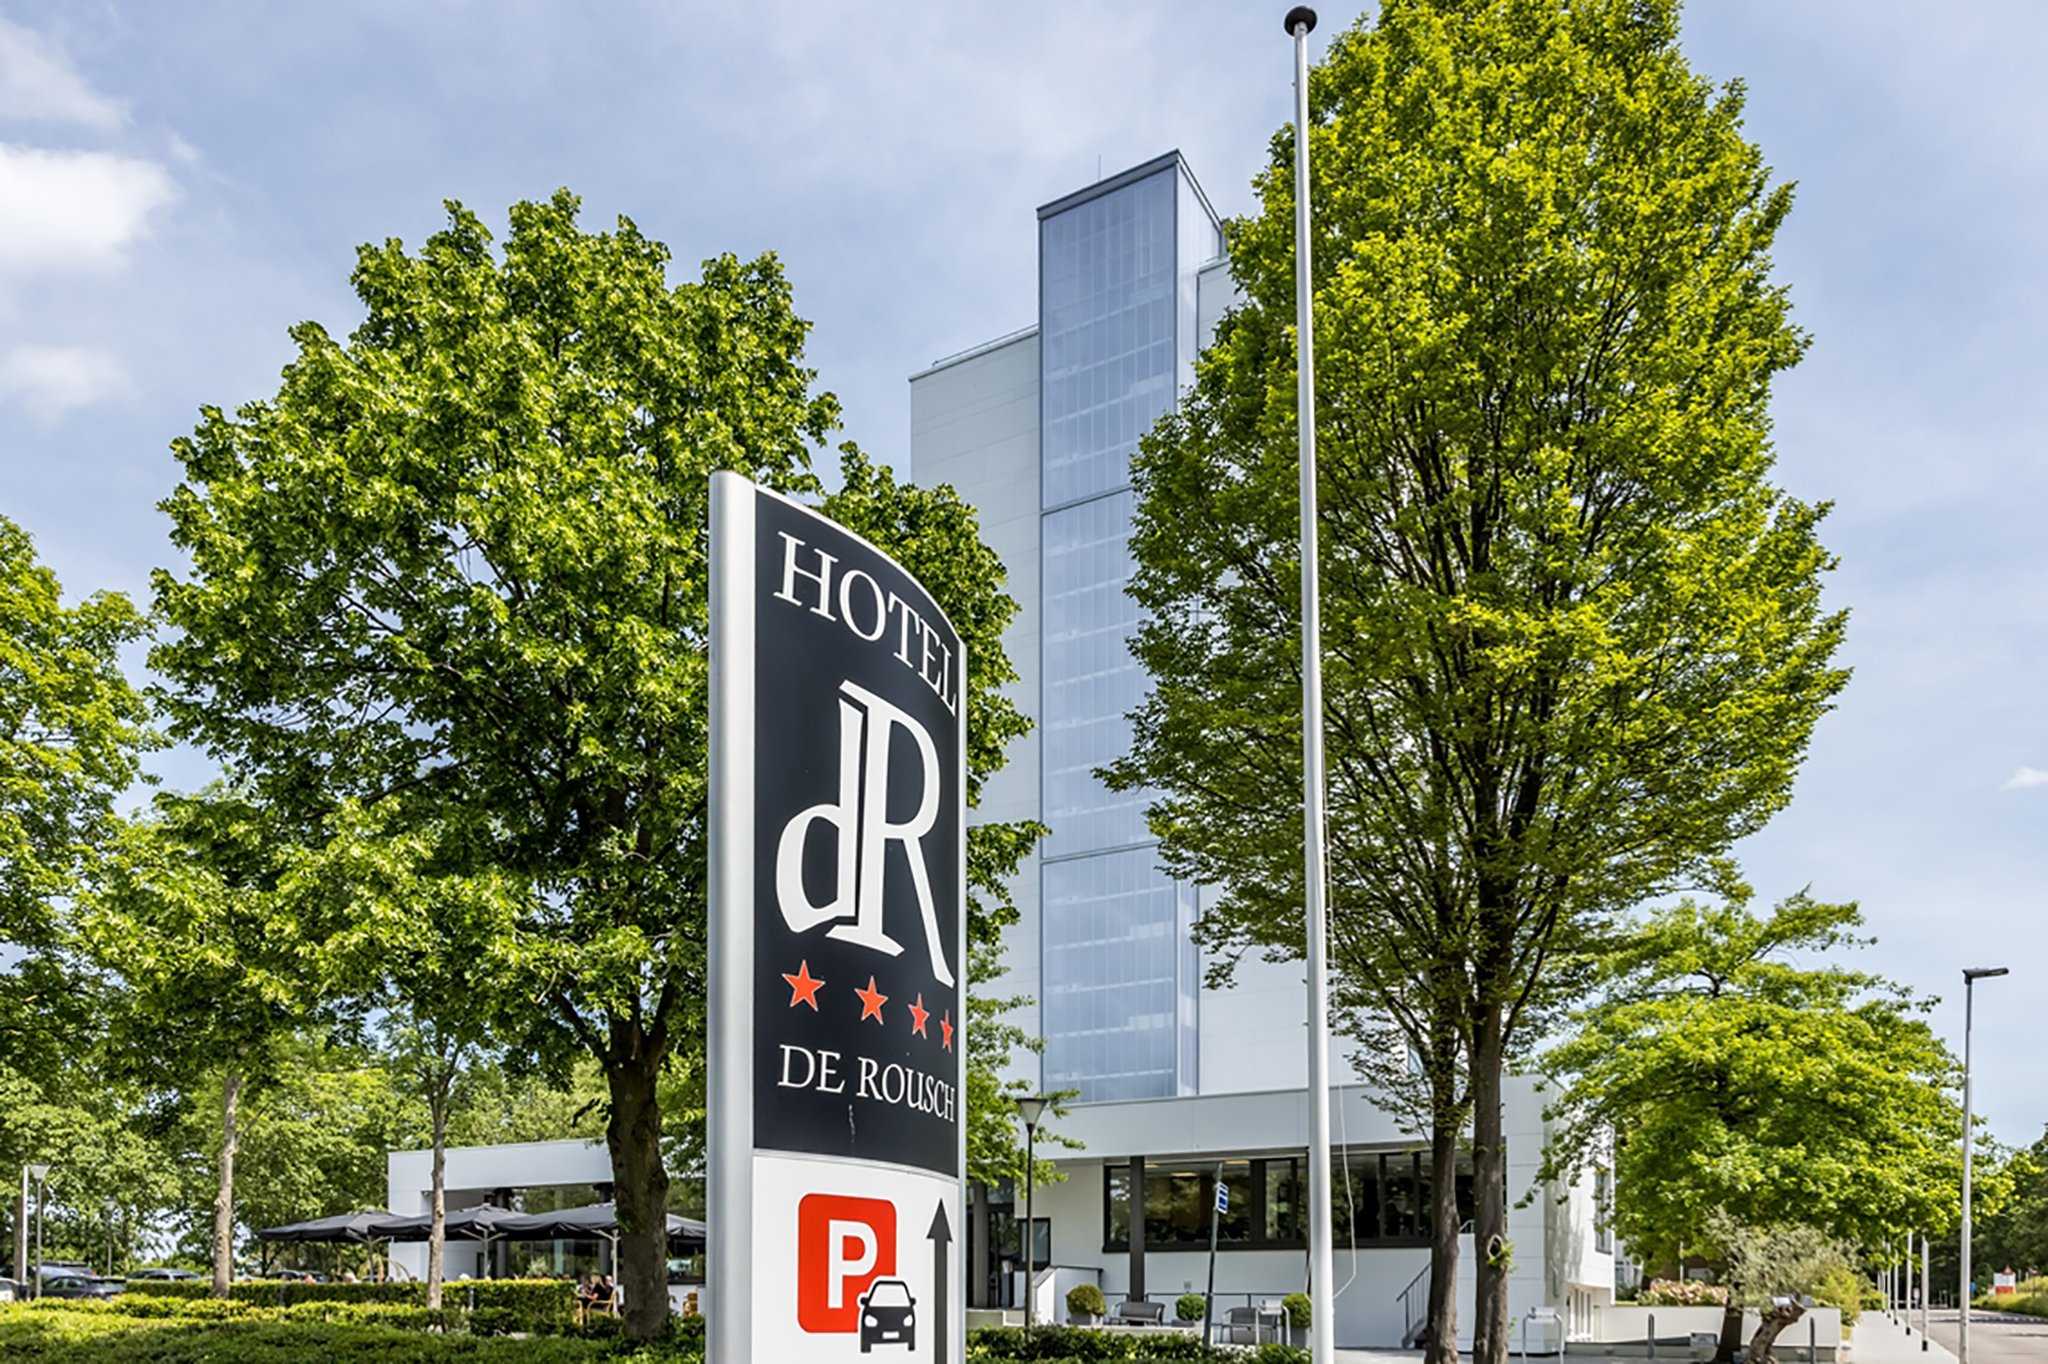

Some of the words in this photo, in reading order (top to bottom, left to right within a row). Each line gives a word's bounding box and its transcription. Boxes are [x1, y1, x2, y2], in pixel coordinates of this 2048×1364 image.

[773, 530, 957, 717] HOTEL
[777, 1044, 846, 1094] DE
[856, 1056, 955, 1122] ROUSCH
[827, 1219, 878, 1309] P
